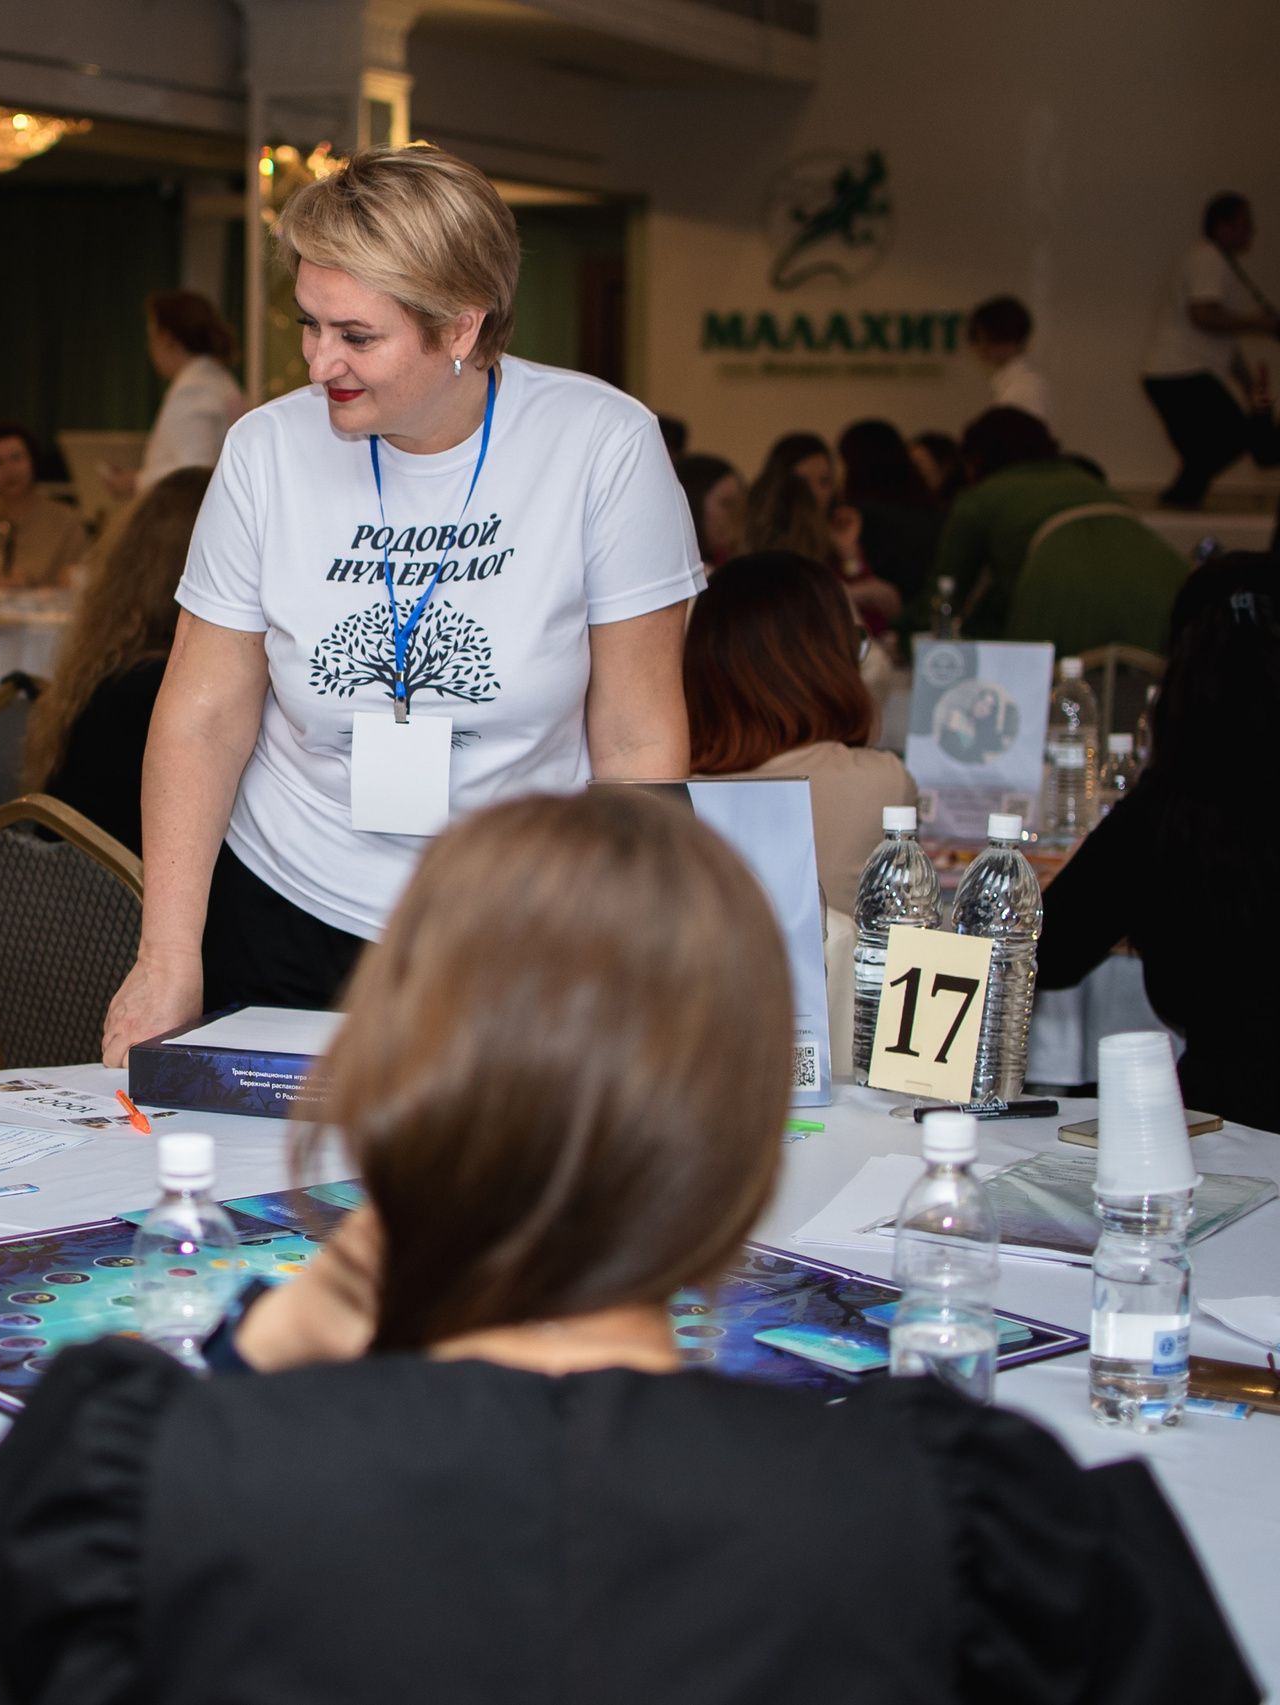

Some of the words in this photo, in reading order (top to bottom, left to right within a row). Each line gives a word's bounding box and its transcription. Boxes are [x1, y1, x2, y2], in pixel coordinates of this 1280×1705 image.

[700, 310, 963, 352] МАЛАХИТ
[351, 513, 502, 557] РОДОВОЙ
[326, 548, 514, 586] НУМЕРОЛОГ
[885, 967, 980, 1064] 17
[231, 1068, 292, 1080] Трансформационная
[240, 1079, 271, 1088] Бережной
